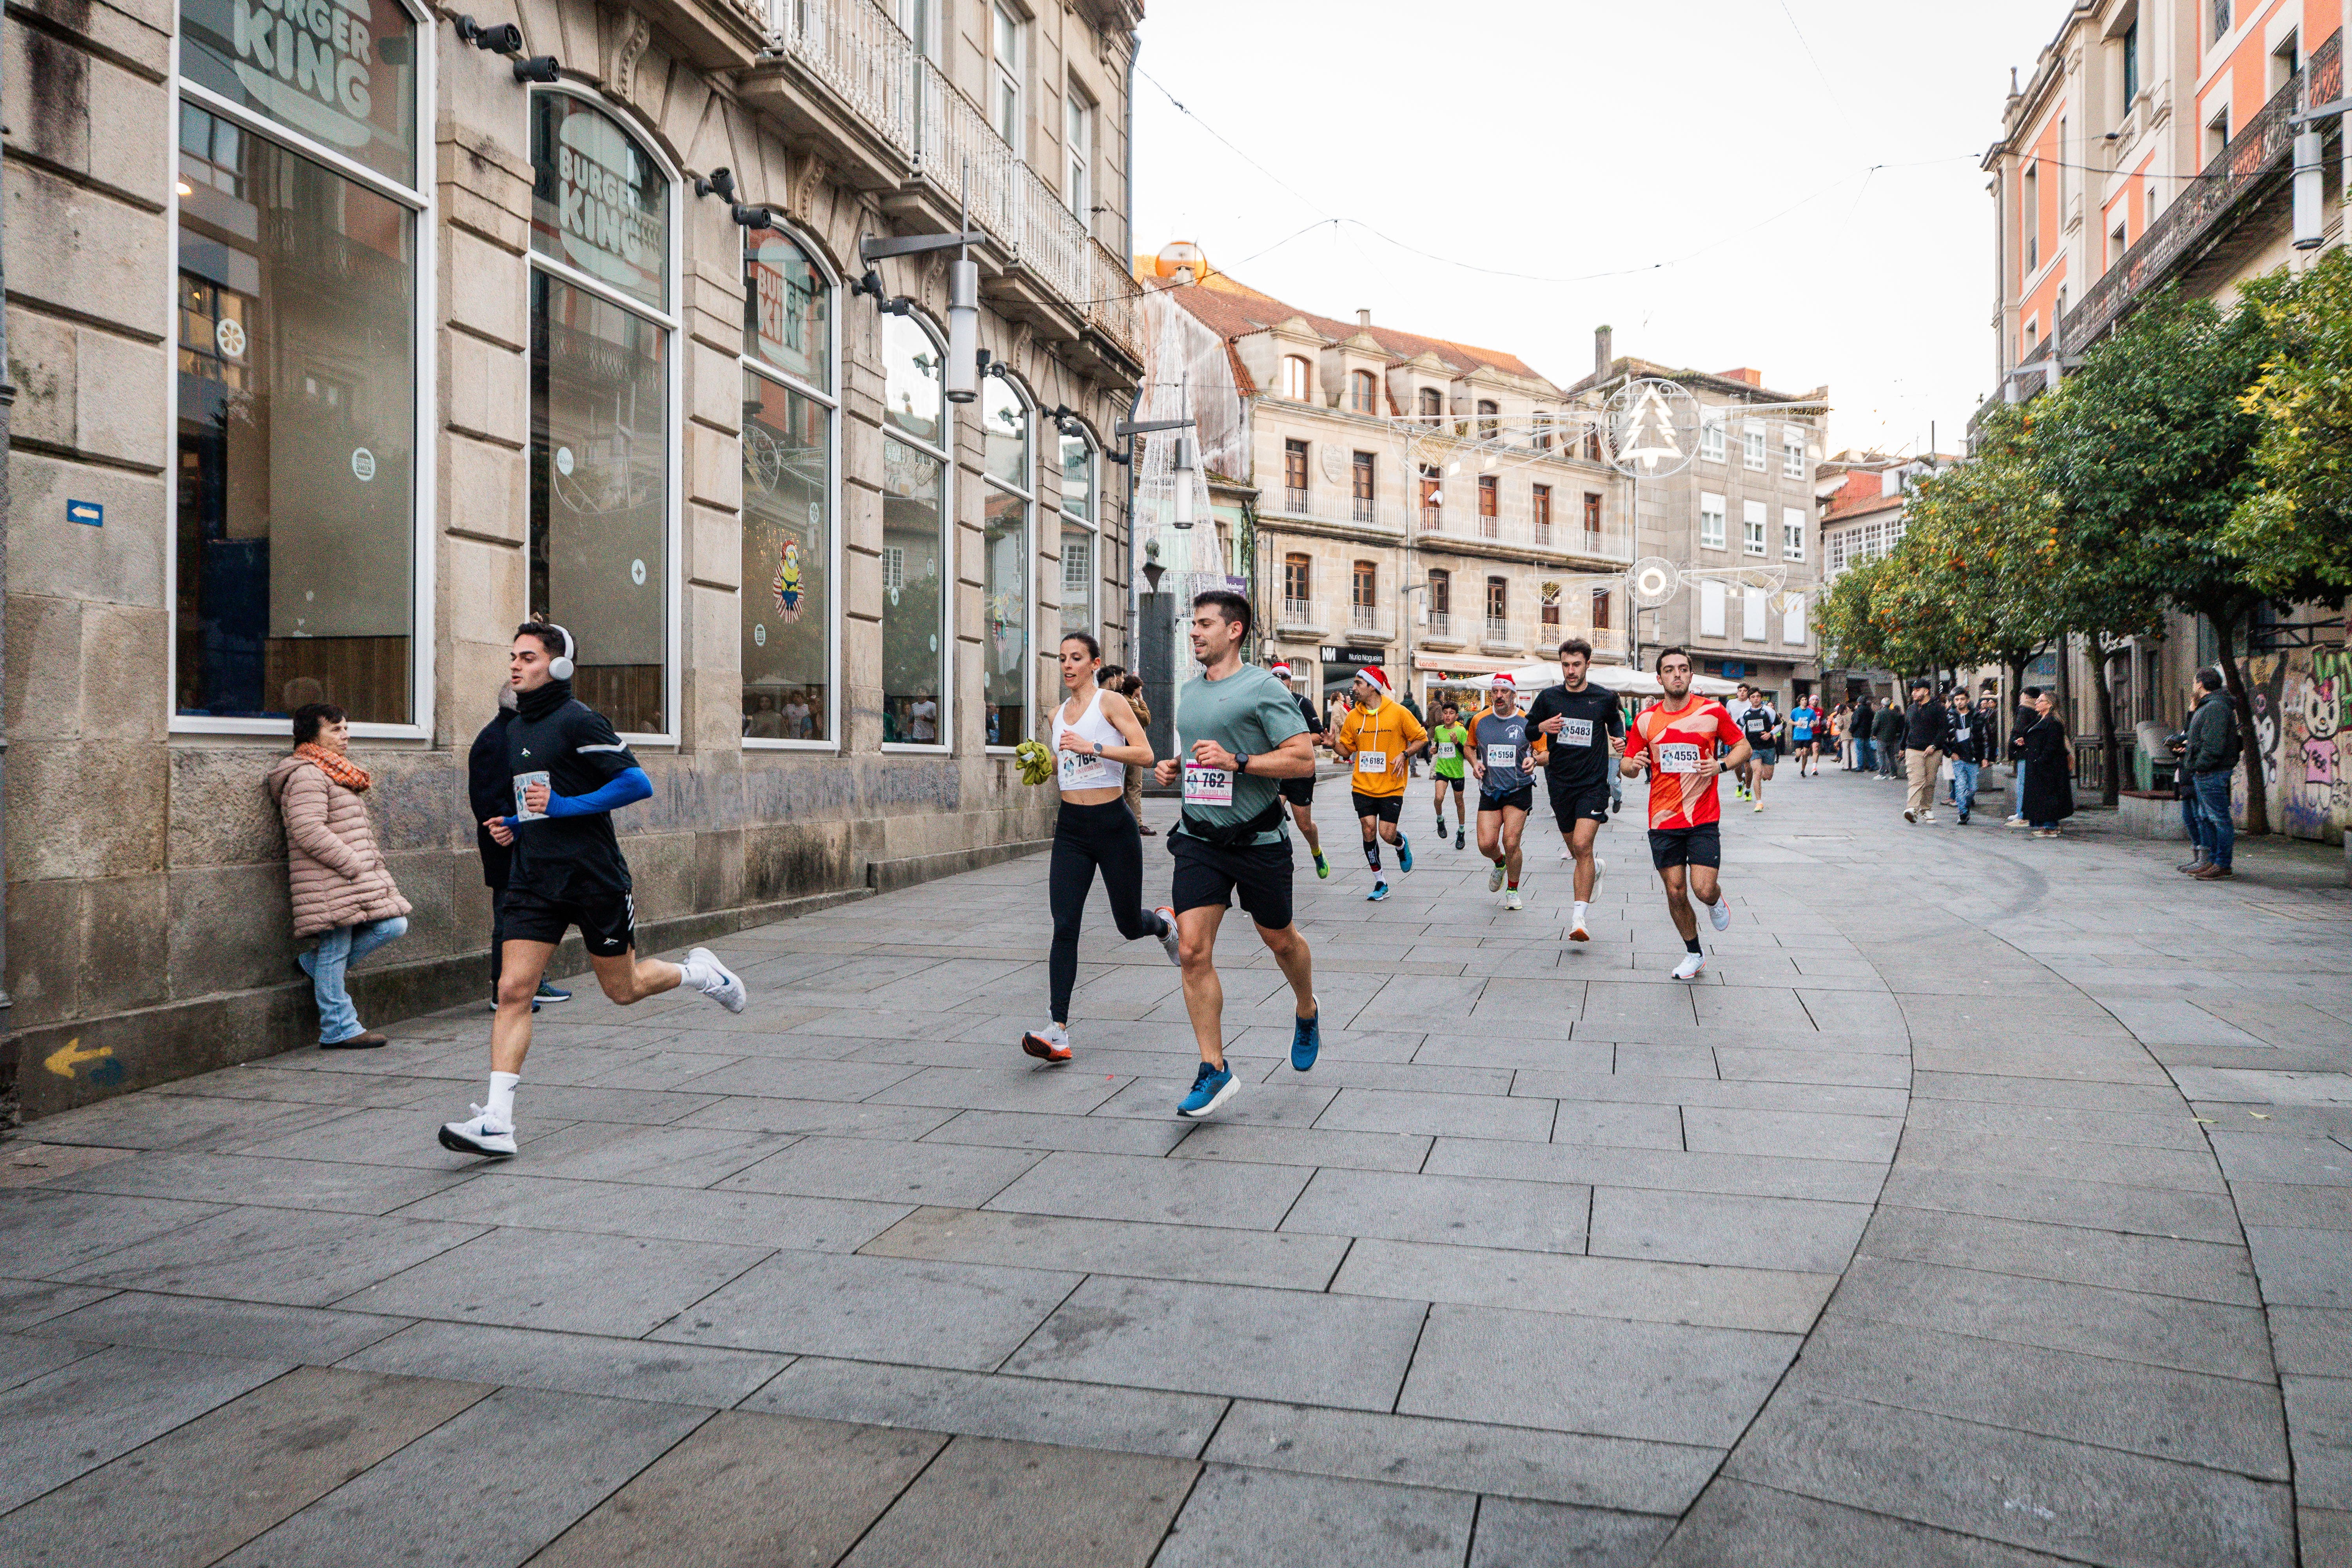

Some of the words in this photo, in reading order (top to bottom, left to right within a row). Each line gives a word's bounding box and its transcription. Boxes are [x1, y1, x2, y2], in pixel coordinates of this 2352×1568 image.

[262, 0, 372, 65] RGER
[234, 0, 372, 118] KING
[559, 145, 641, 223] BURGER
[559, 180, 642, 264] KING
[1362, 654, 1383, 662] Nogueira
[1570, 726, 1590, 736] 5483
[1076, 754, 1096, 767] 764
[1674, 751, 1698, 761] 4553
[1202, 772, 1225, 788] 762
